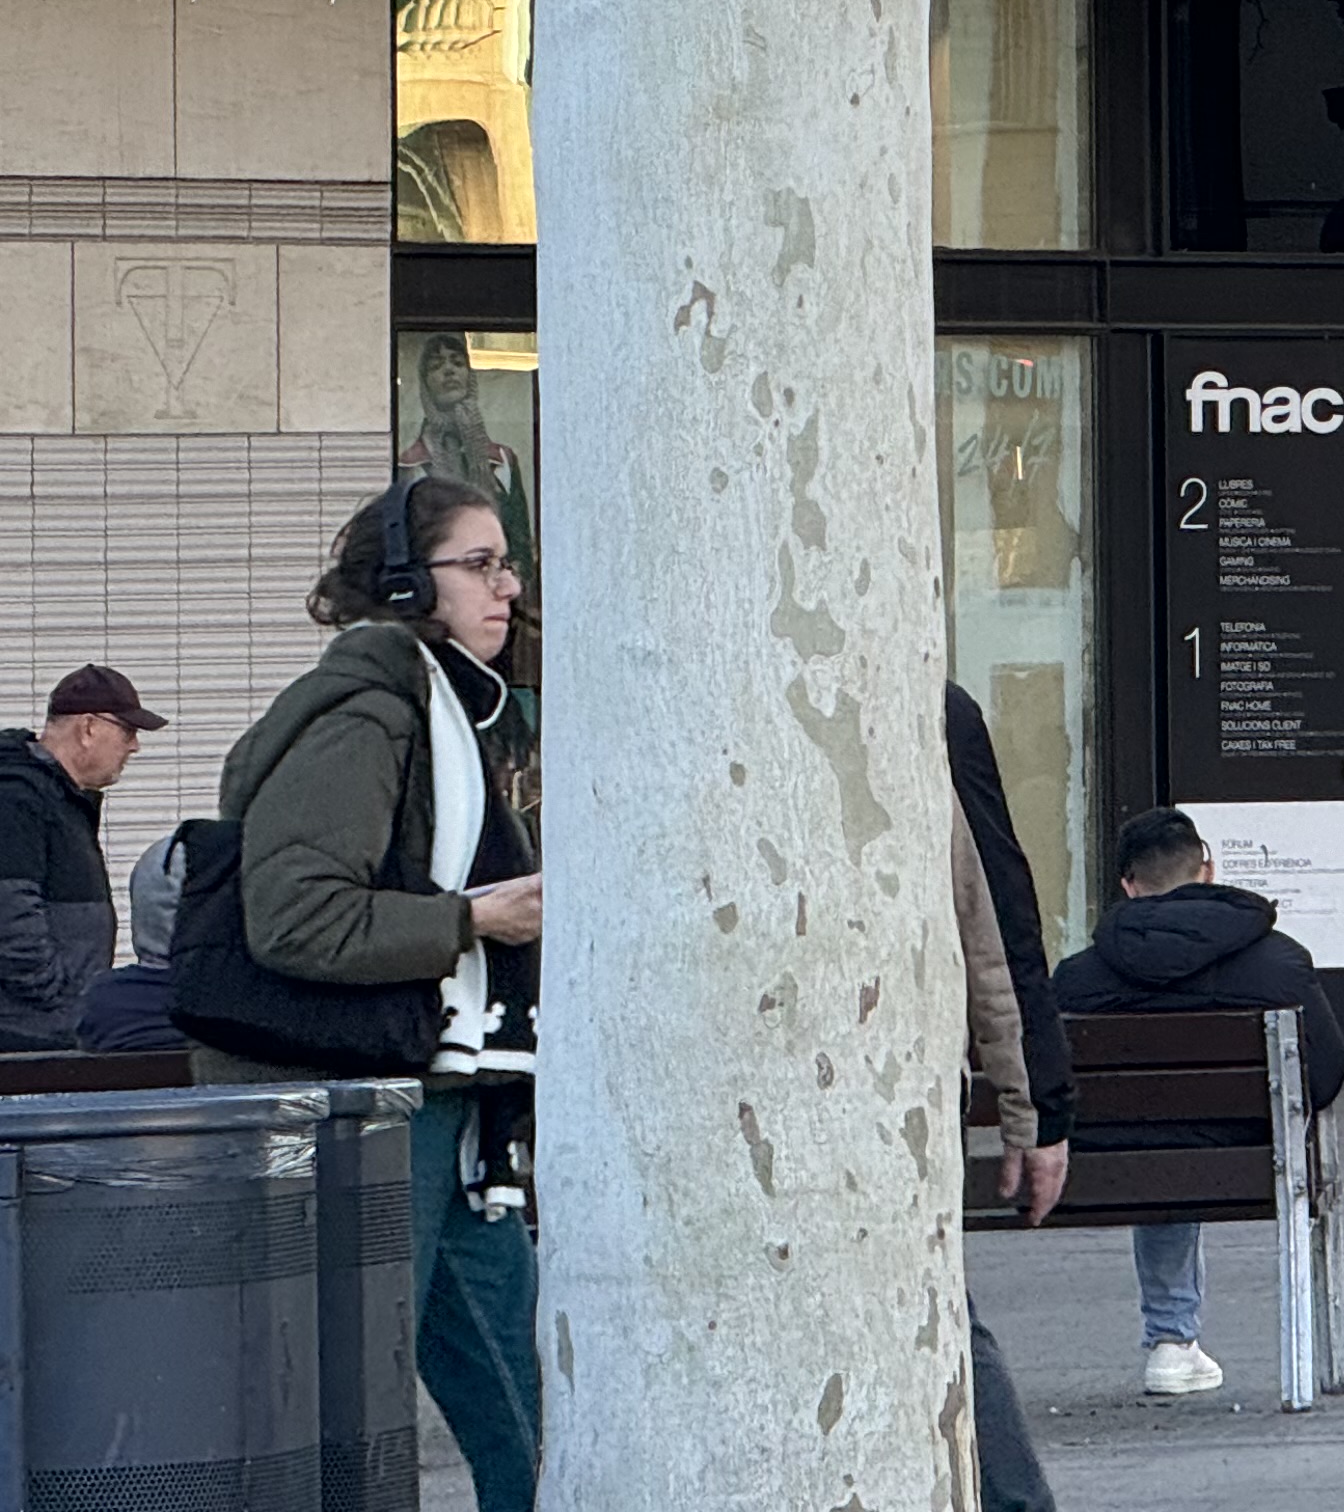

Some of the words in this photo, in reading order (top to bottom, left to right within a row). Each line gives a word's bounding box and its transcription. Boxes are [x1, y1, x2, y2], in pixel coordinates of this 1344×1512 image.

[1186, 370, 1344, 434] fnac
[1180, 478, 1208, 529] 2
[1219, 575, 1290, 585] MERCHANDISING
[1184, 627, 1200, 678] 1
[1221, 720, 1270, 731] SOLUCIONS
[1272, 720, 1302, 730] CLIENT
[1274, 740, 1297, 750] FREE
